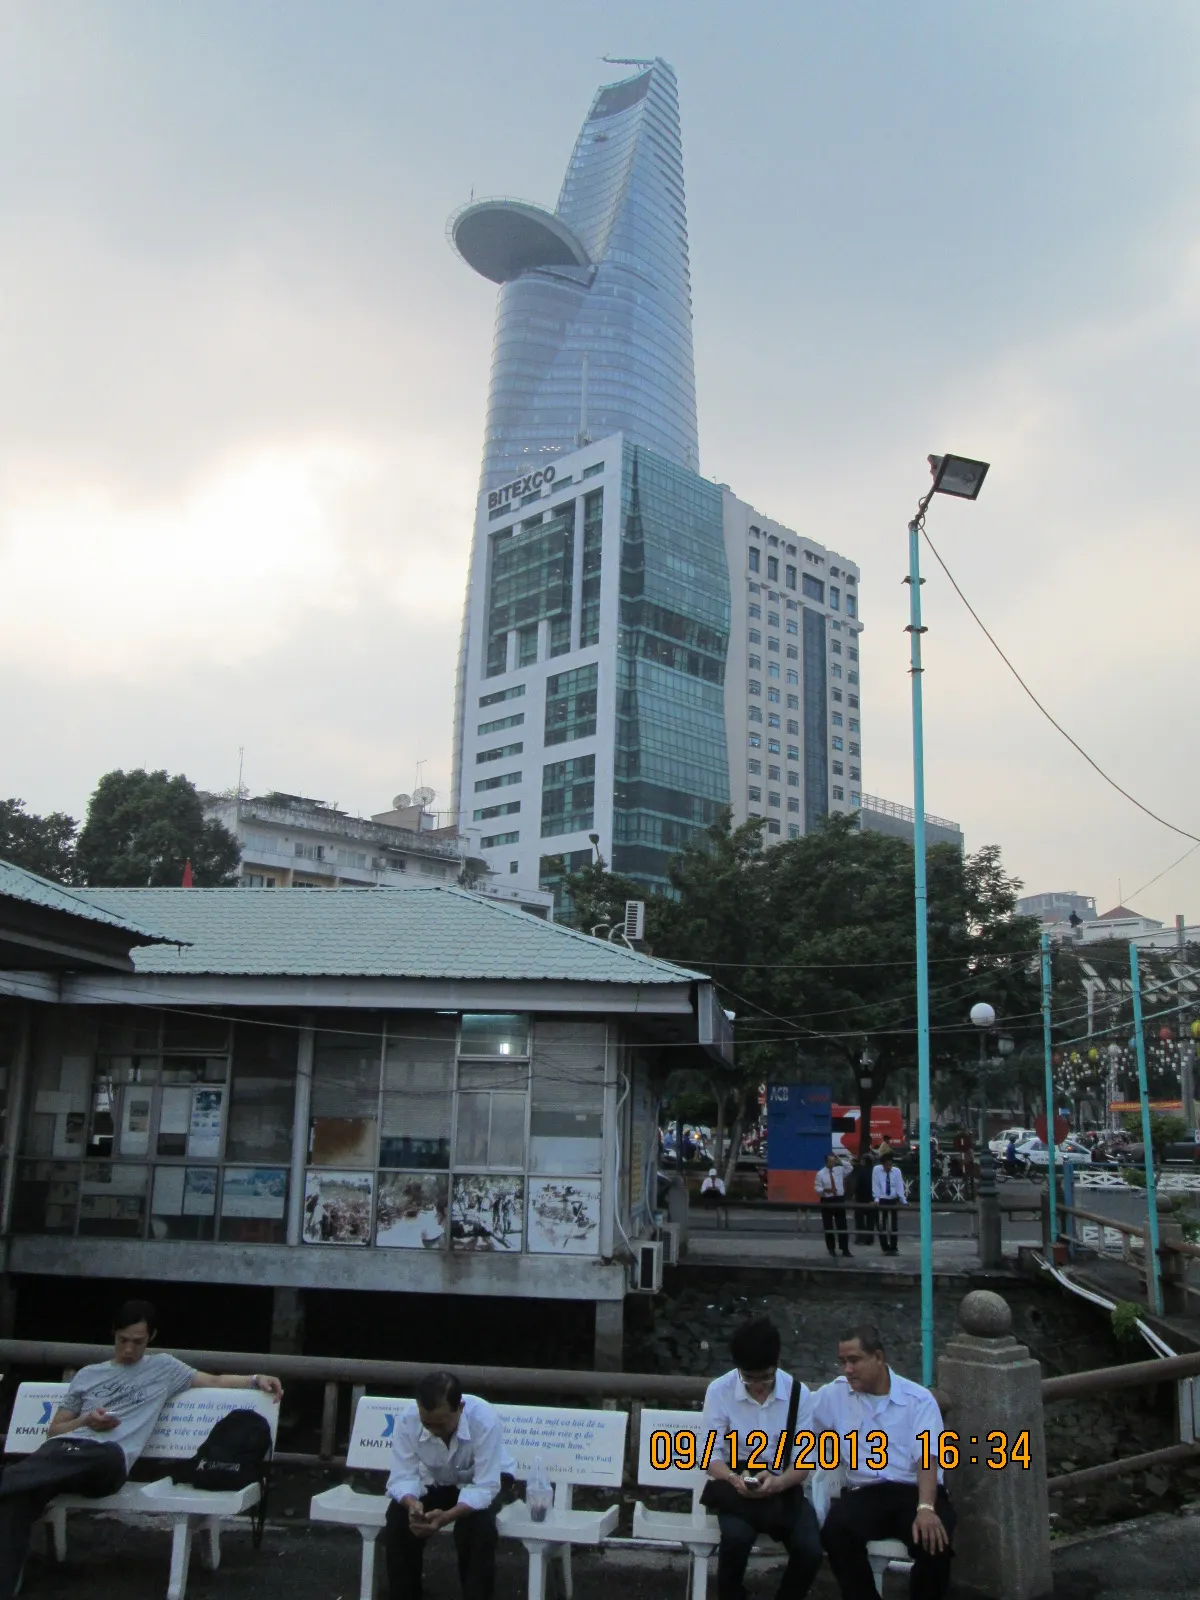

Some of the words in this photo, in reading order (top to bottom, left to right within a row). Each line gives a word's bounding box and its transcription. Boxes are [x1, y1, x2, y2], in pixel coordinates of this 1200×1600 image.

[488, 465, 556, 510] BITEXCO
[770, 1086, 789, 1101] ACB
[360, 1438, 384, 1448] KHAI
